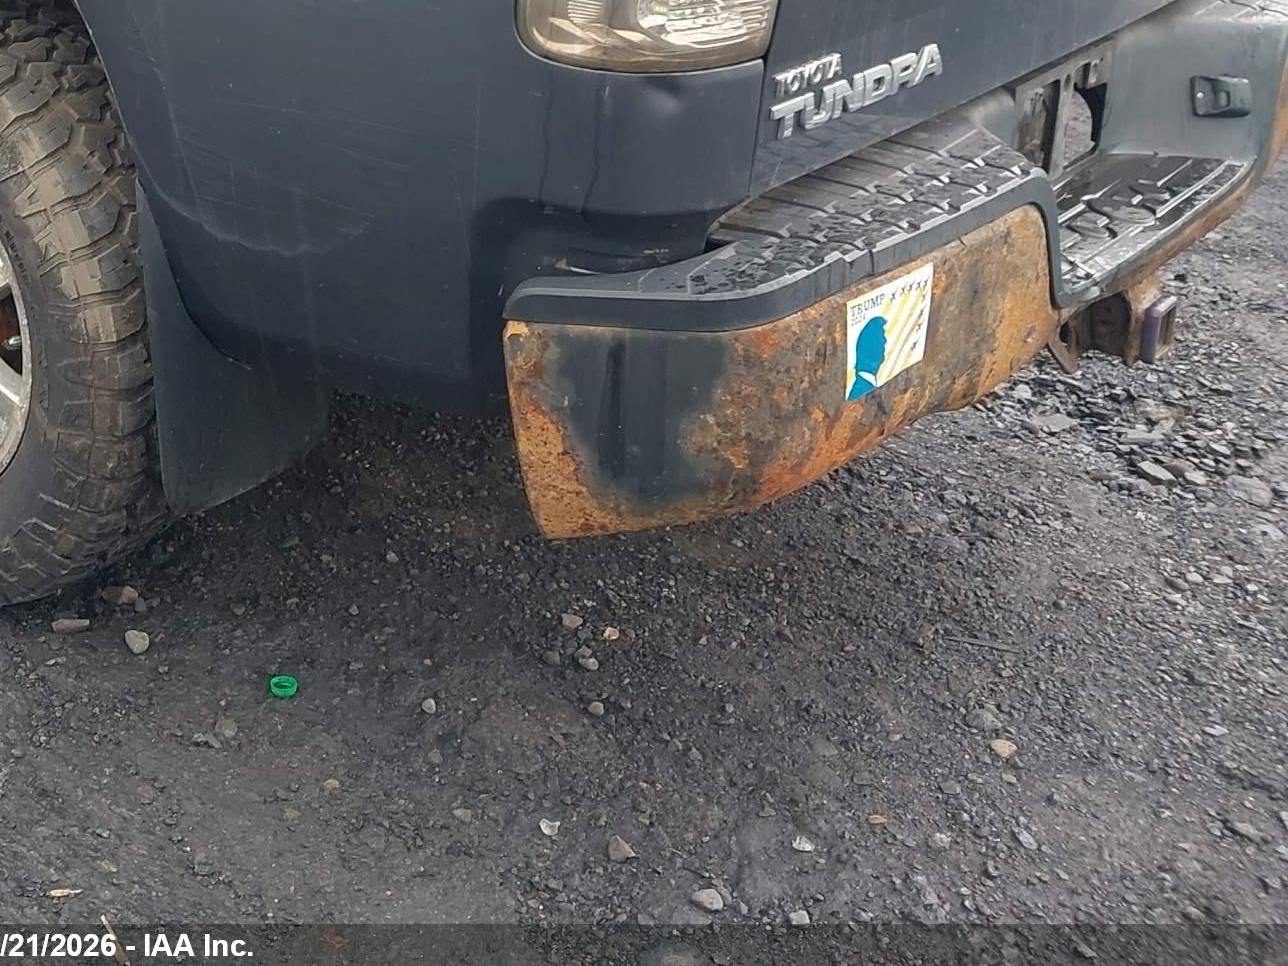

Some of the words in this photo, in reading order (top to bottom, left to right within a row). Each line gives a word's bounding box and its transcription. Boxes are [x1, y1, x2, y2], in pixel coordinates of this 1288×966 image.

[769, 43, 943, 139] TUNDRA
[773, 53, 843, 98] TOYOTA
[850, 293, 886, 318] TRUMP
